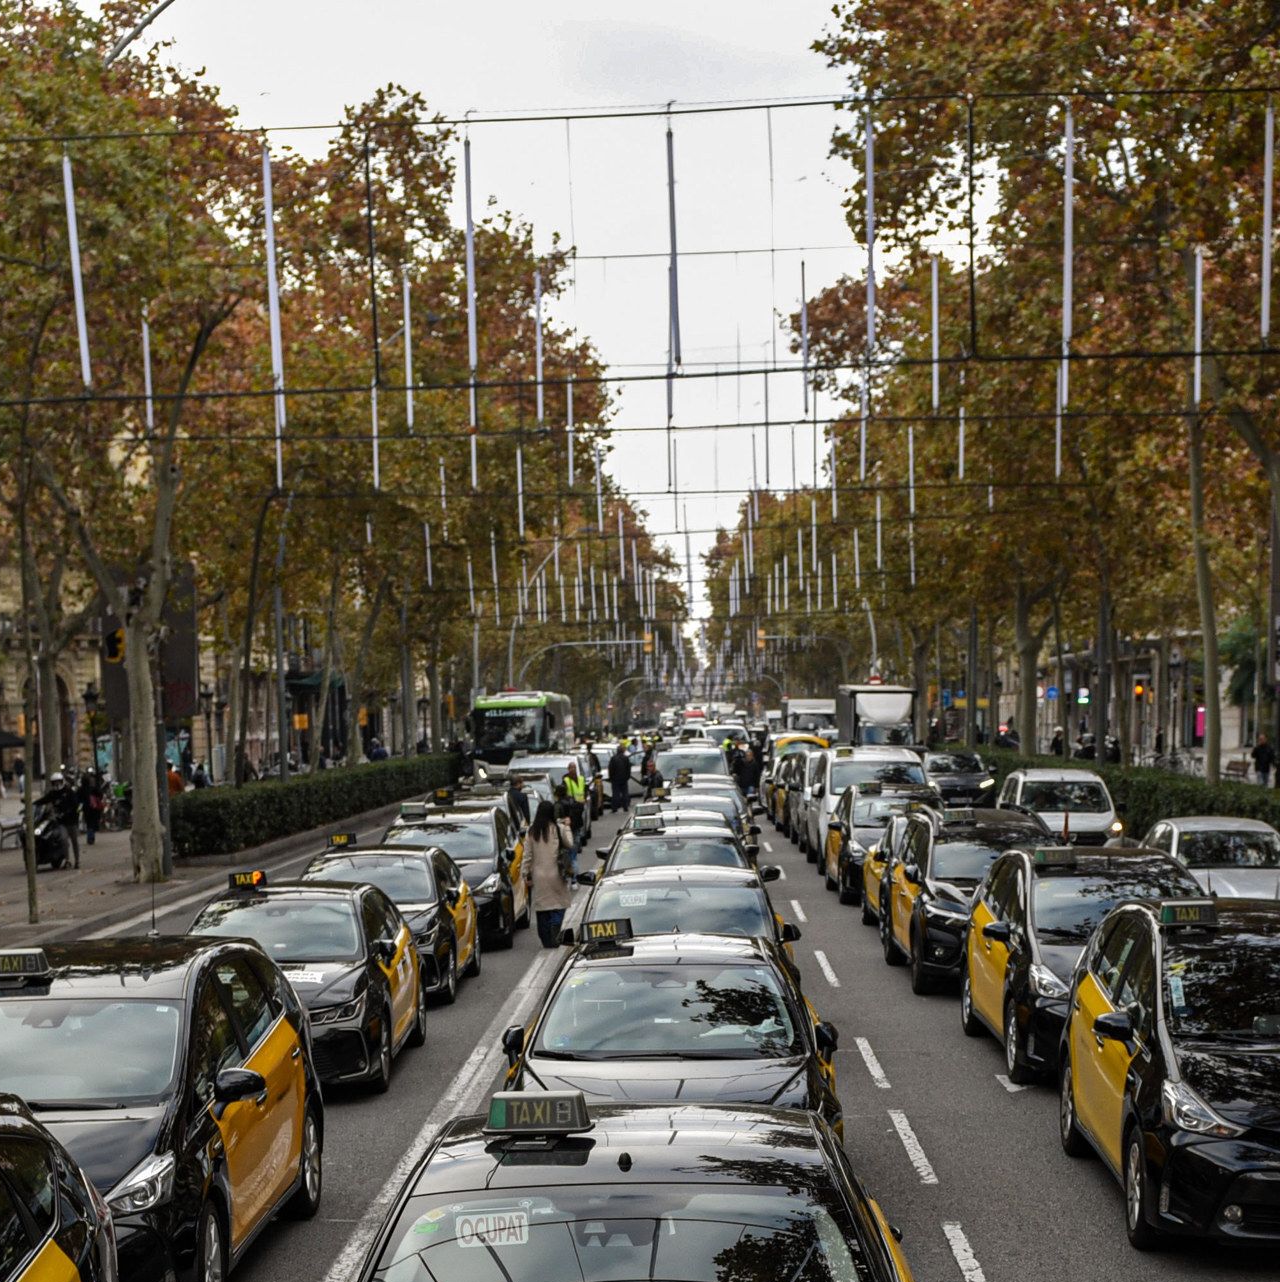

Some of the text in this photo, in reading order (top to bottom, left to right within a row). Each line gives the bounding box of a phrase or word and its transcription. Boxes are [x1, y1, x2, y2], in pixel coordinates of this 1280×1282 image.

[1175, 907, 1200, 921] TAXI
[589, 922, 617, 938] TAXI
[0, 956, 23, 972] TAXI
[510, 1101, 551, 1124] TAXI
[460, 1214, 525, 1244] OCUPAT
